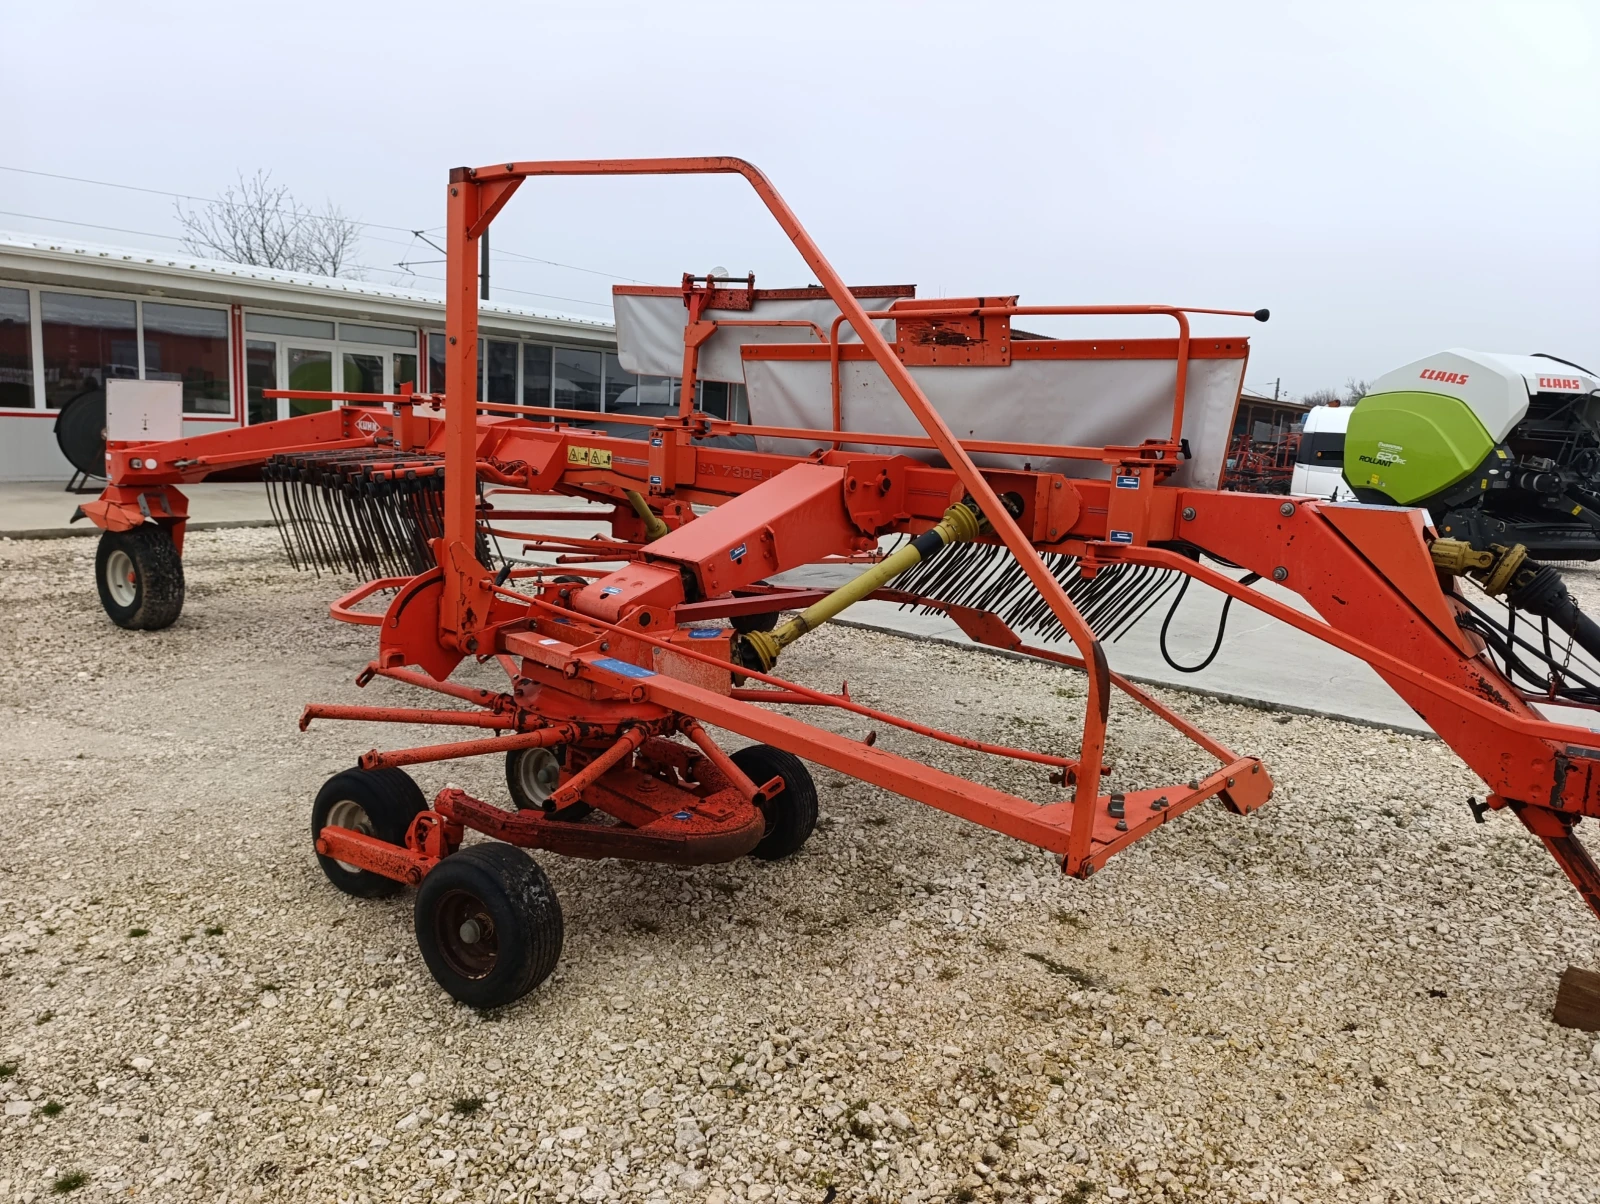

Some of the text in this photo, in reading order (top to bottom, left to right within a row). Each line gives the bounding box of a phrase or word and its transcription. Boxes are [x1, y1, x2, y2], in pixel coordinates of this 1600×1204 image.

[1419, 368, 1469, 385] CLAAS
[1539, 377, 1580, 390] CLAAS
[1358, 455, 1393, 467] ROLLANT
[722, 465, 763, 481] 7302
